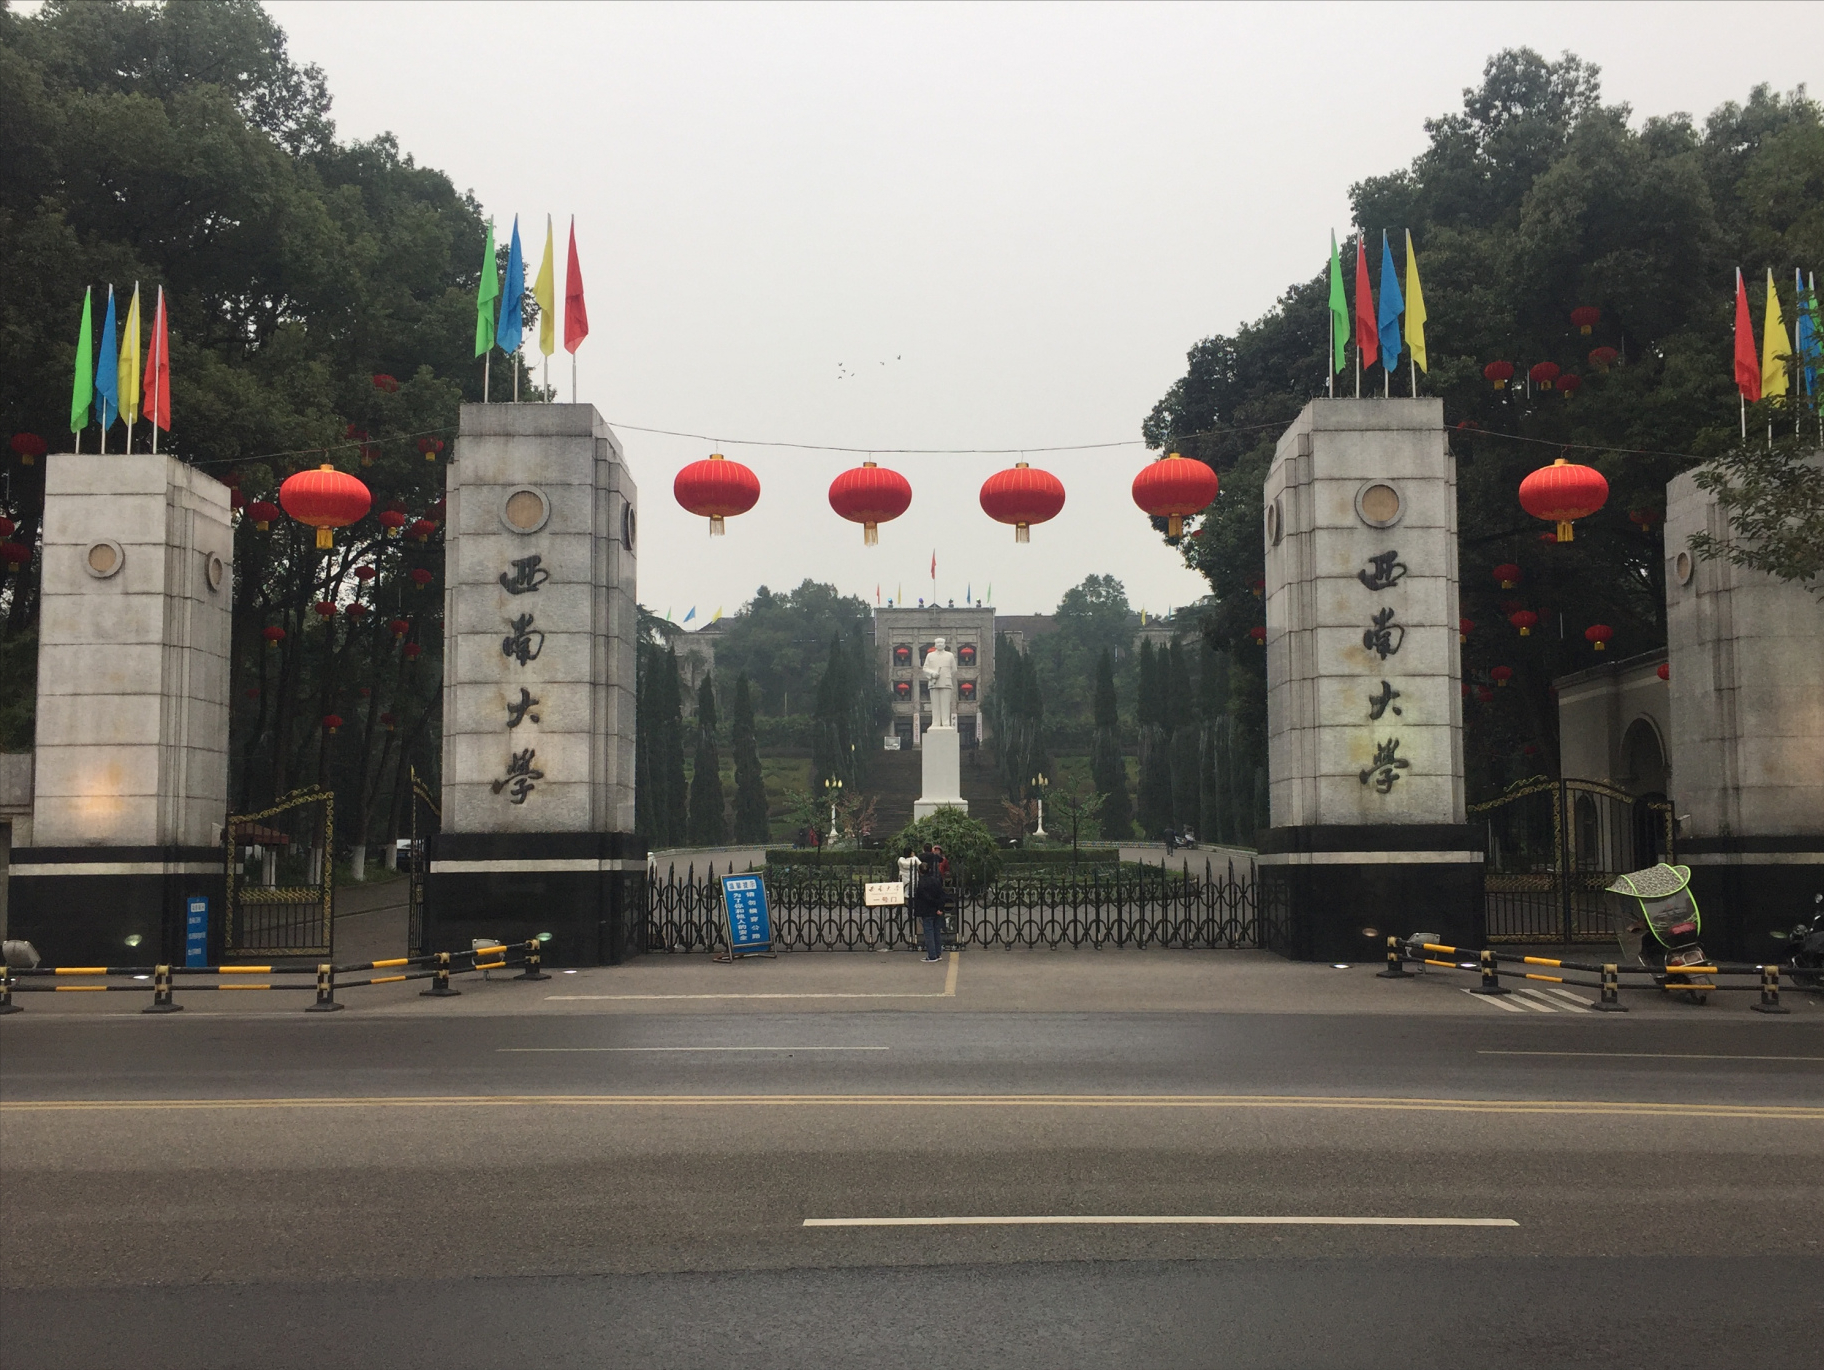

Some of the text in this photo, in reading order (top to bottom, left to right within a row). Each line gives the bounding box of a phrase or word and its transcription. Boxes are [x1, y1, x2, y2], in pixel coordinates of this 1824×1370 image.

[733, 893, 748, 941] 为了你和他人的安全
[746, 891, 761, 940] 请勿横穿公路
